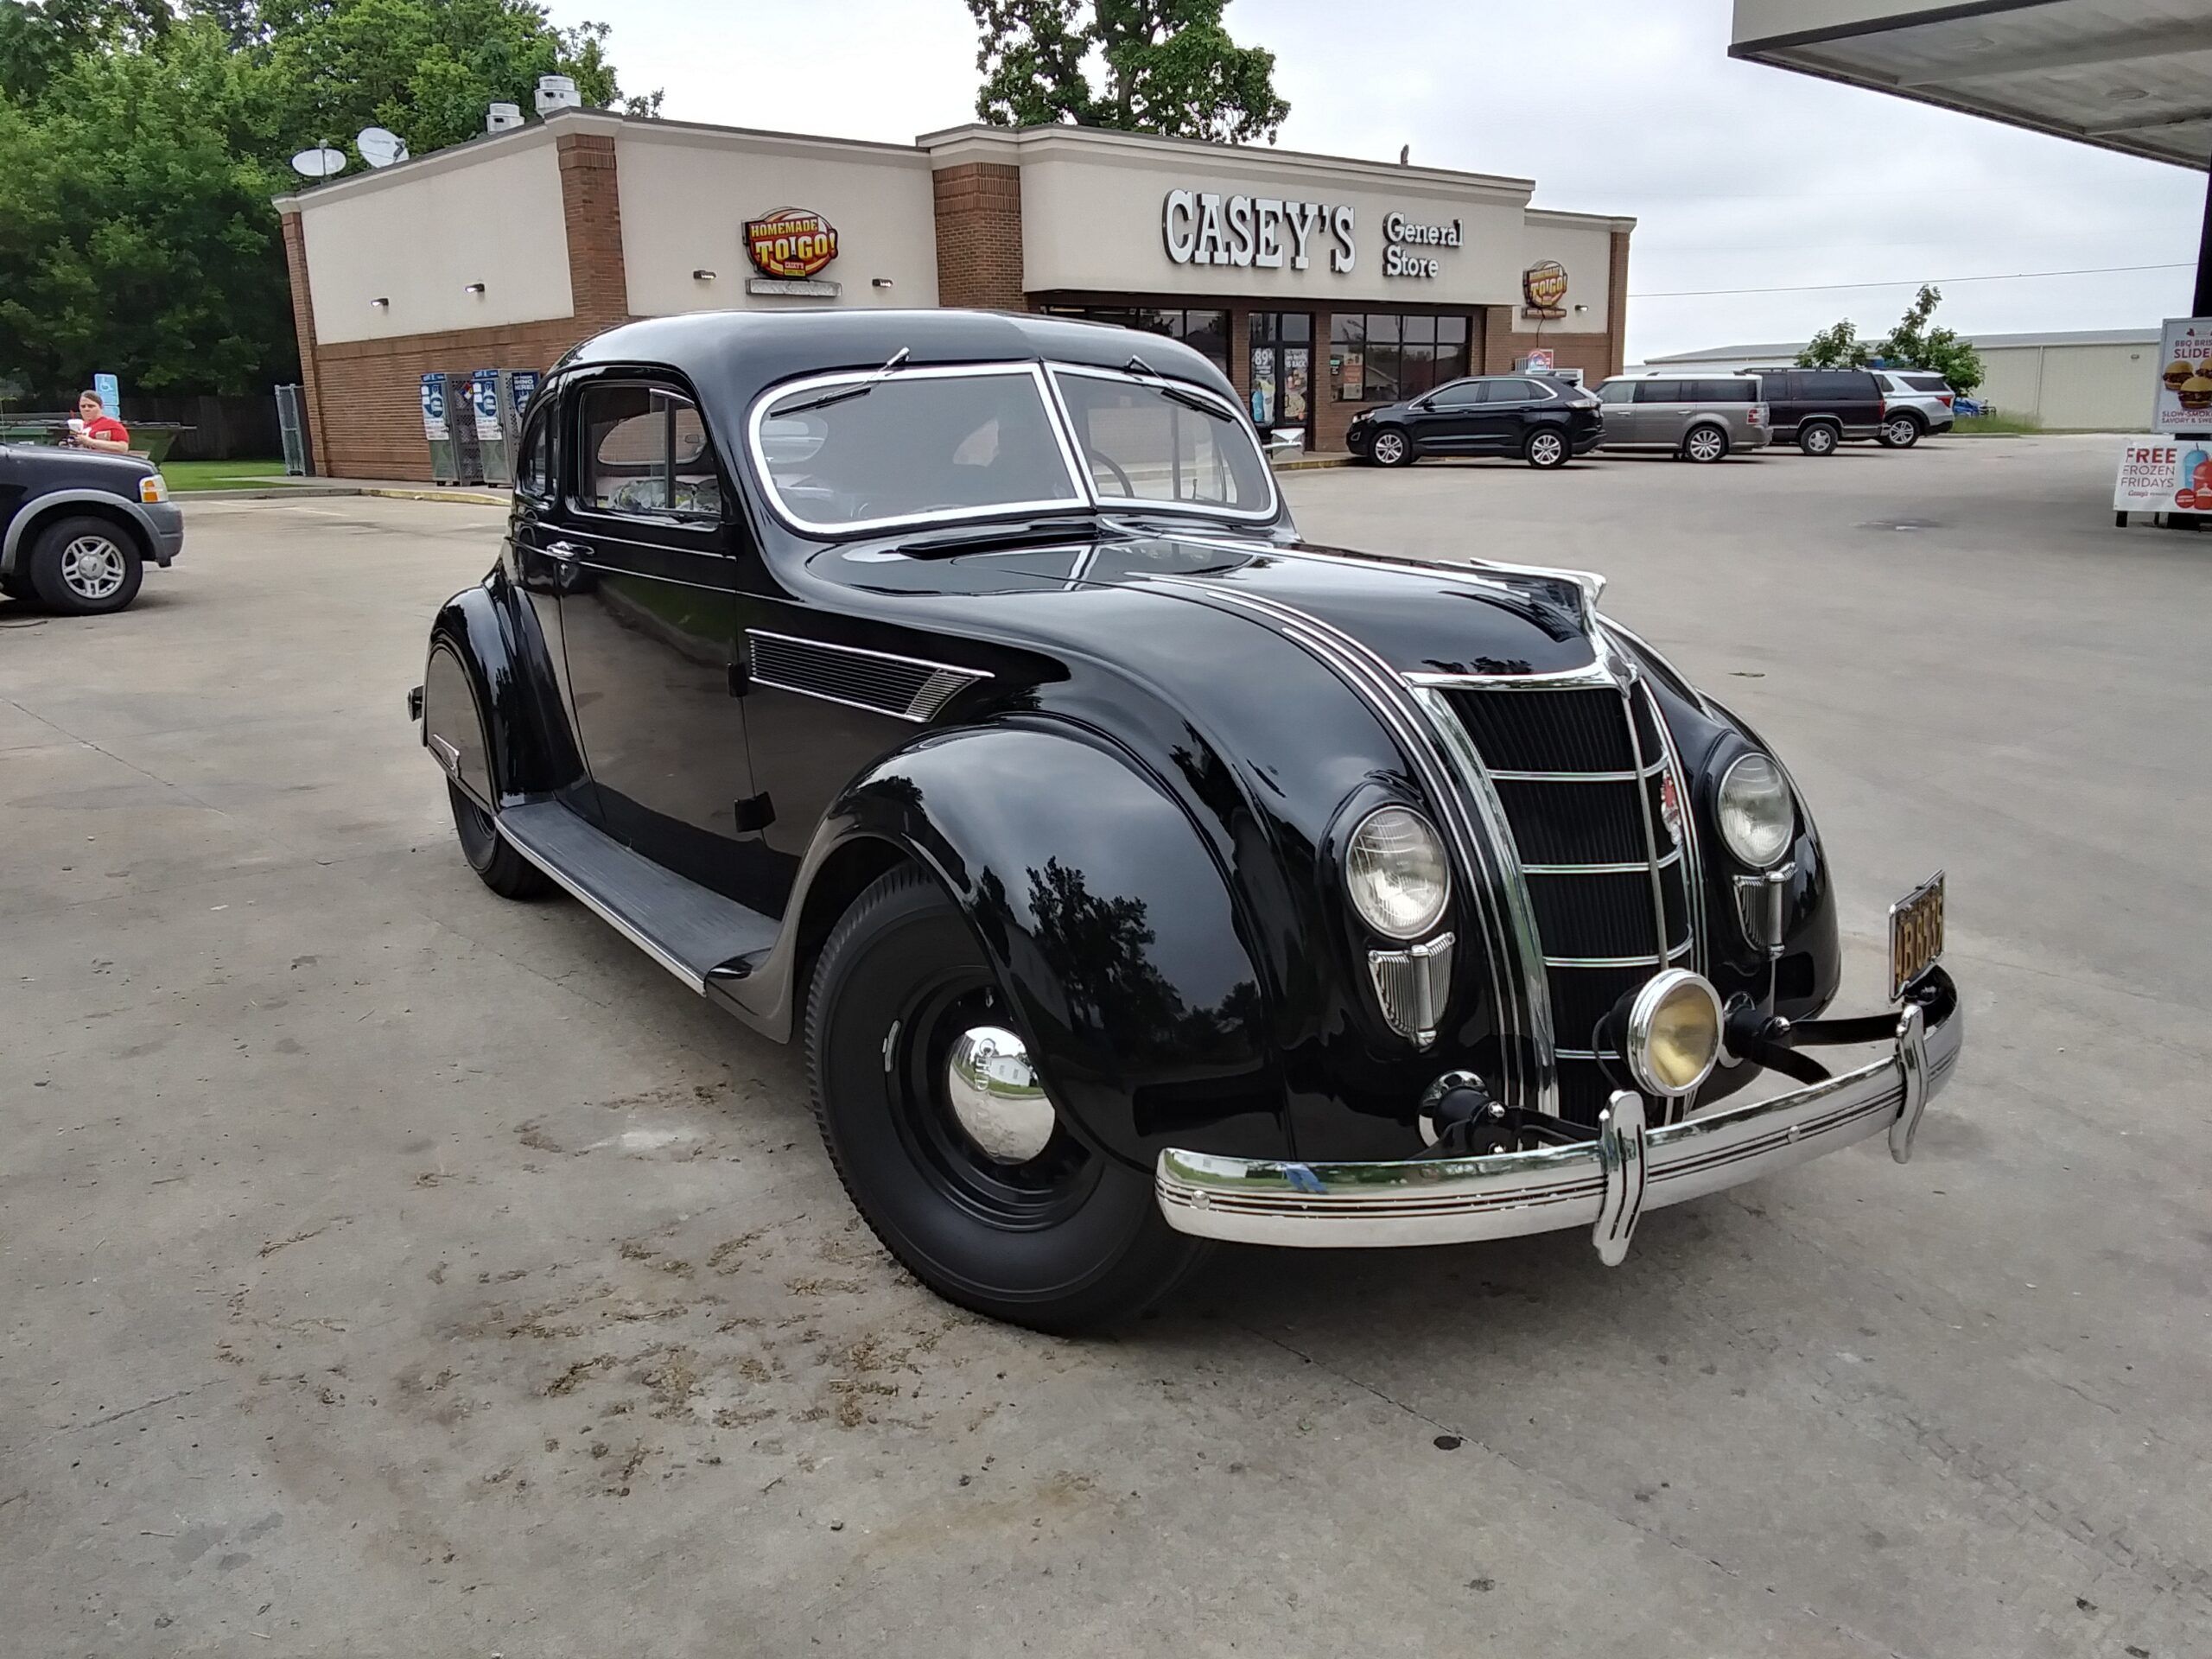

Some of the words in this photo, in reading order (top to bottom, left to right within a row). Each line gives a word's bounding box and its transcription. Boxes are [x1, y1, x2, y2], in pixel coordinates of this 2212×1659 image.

[750, 219, 817, 238] HOMEMADE
[1163, 188, 1356, 273] CASEY'S
[1384, 211, 1464, 246] General
[1384, 244, 1440, 277] Store
[2173, 347, 2212, 359] SLIDE
[2126, 448, 2177, 463] FREE
[2123, 465, 2175, 475] FROZEN
[2120, 477, 2174, 487] FRIDAYS
